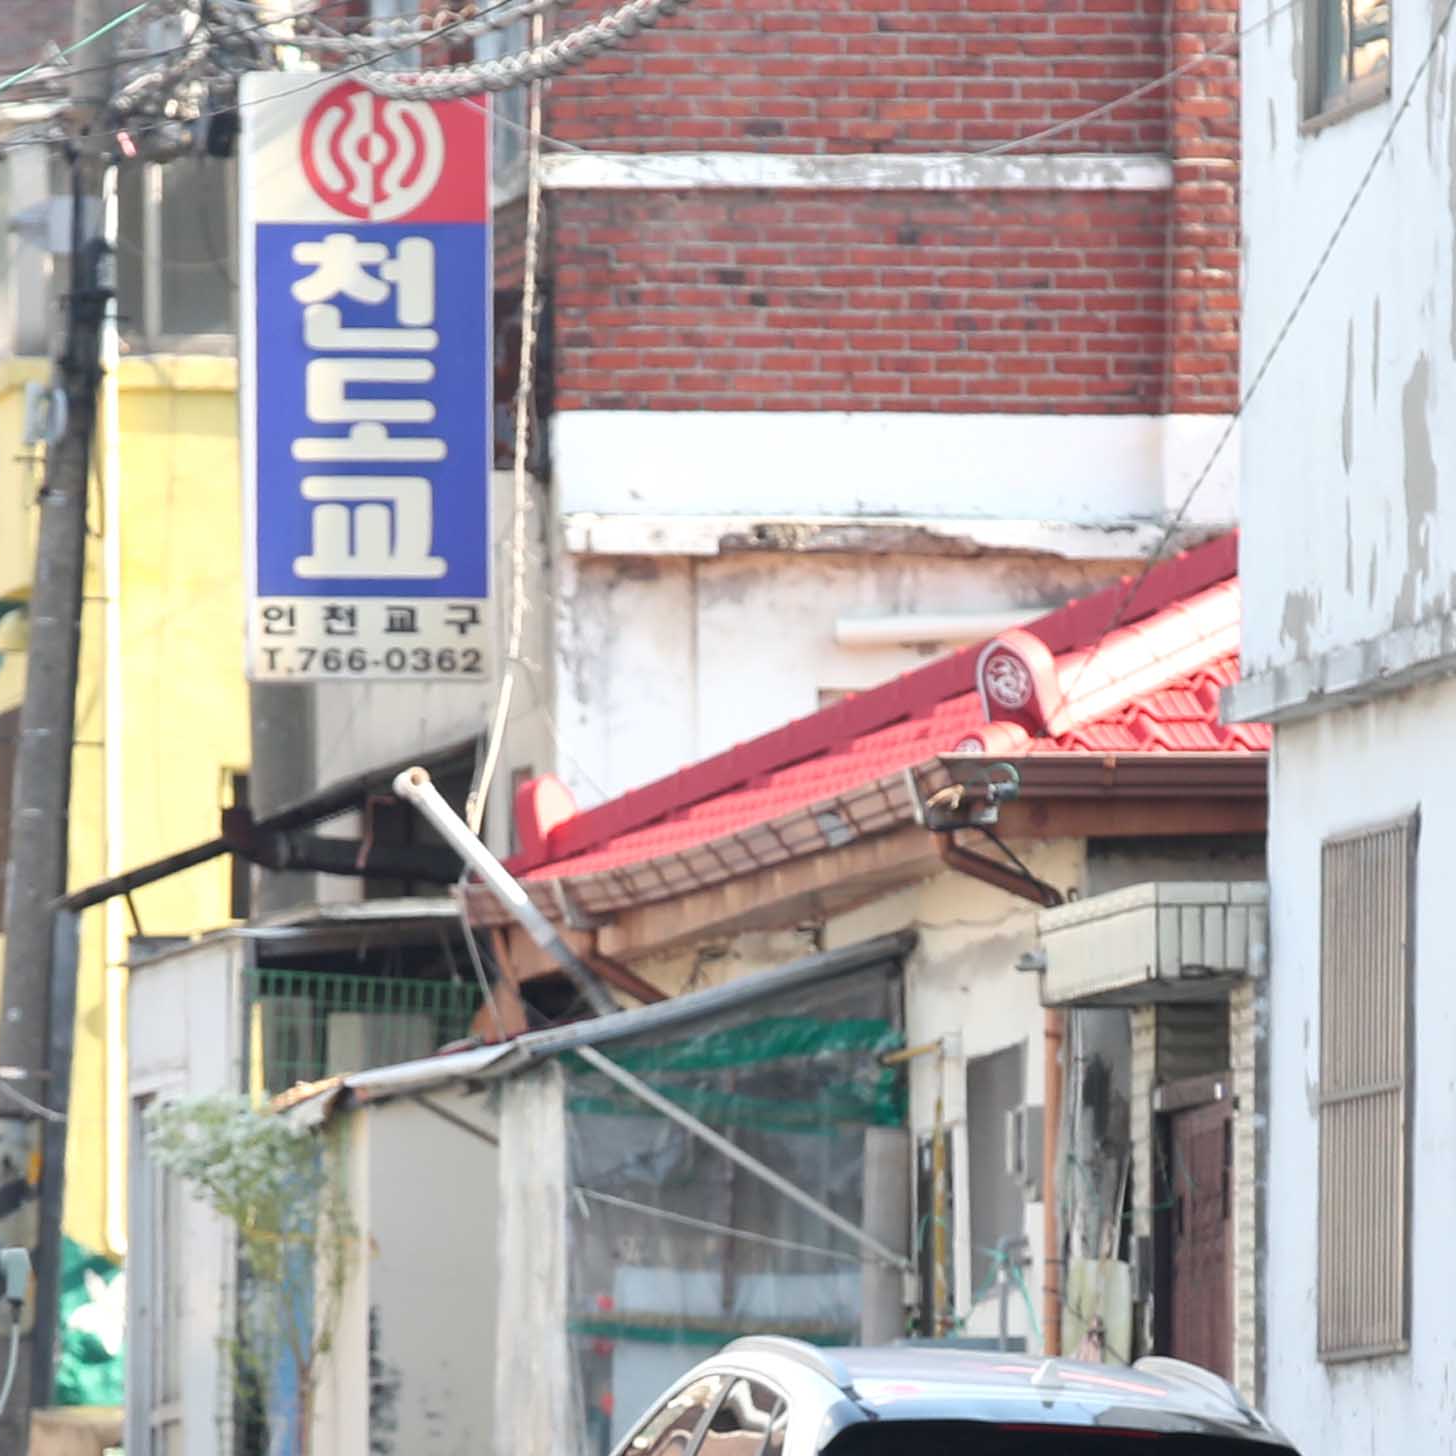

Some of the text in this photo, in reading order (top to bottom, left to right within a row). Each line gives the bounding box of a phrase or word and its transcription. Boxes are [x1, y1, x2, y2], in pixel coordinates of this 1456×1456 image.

[291, 232, 448, 580] 천도교
[262, 605, 482, 636] 인천교구
[262, 647, 484, 677] T.766-0362
